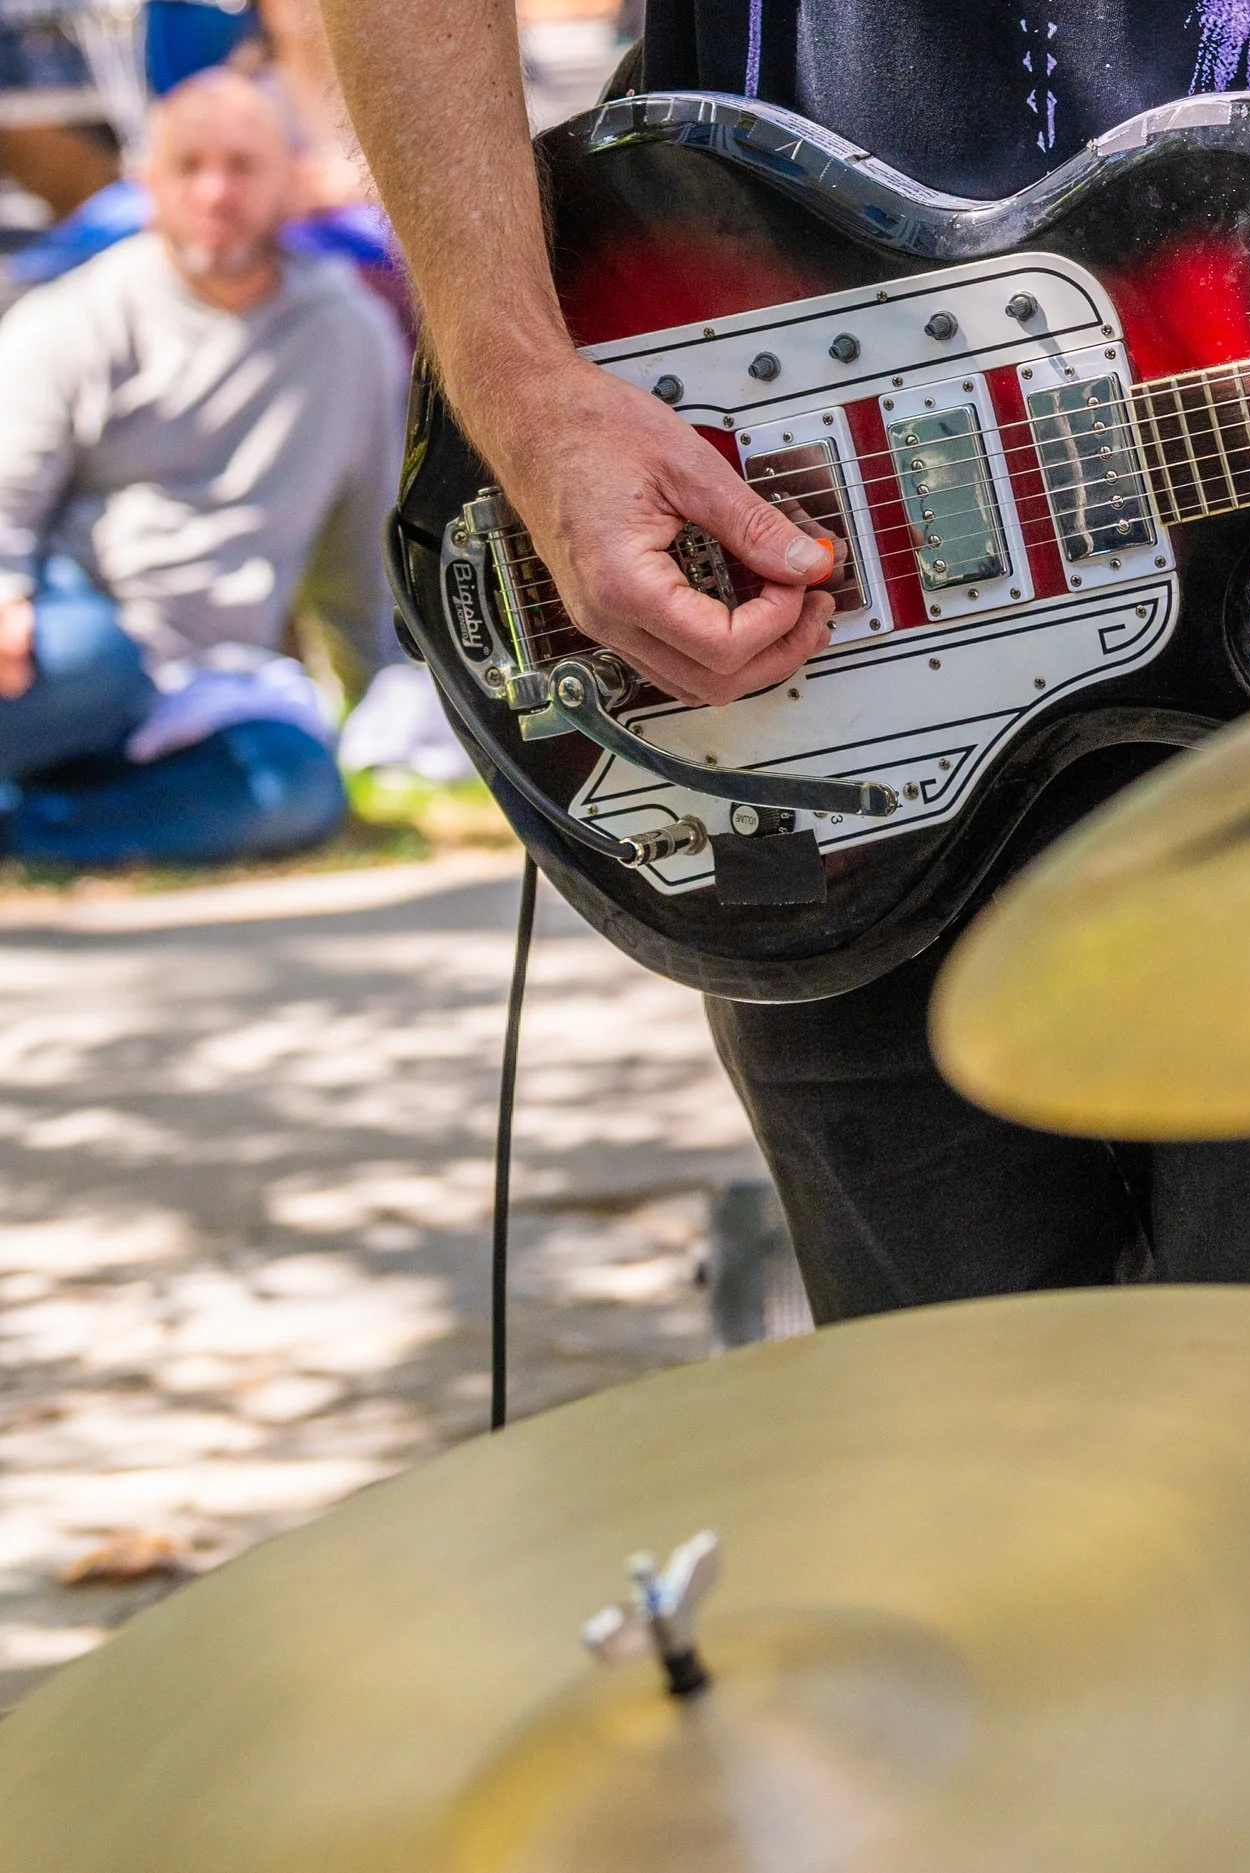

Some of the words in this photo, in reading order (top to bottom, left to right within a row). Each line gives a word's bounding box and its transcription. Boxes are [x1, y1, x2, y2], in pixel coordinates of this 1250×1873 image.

[452, 563, 484, 648] Bigsby
[455, 603, 469, 640] LICENSED
[734, 813, 757, 826] VOLUME
